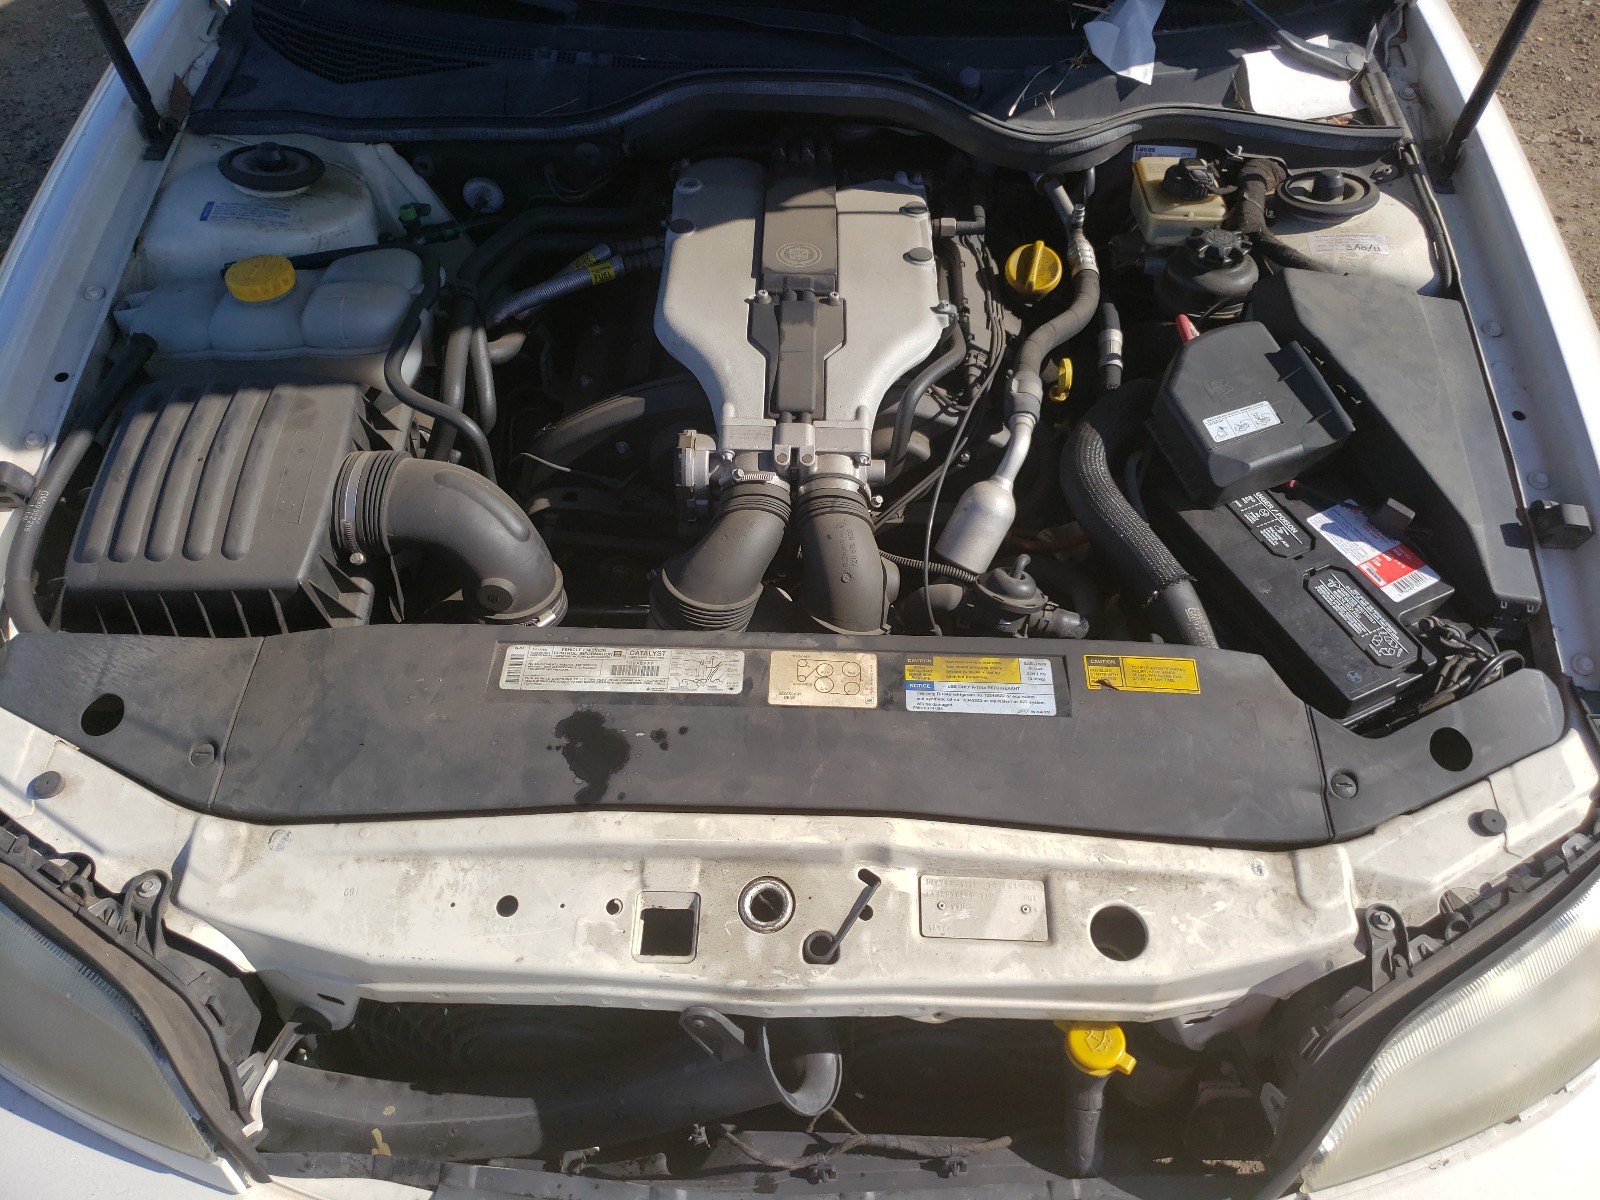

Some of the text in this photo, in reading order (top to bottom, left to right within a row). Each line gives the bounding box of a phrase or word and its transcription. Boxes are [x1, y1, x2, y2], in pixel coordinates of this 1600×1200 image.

[576, 258, 593, 268] FUEL
[594, 272, 612, 281] FUEL
[1276, 512, 1298, 534] POISON
